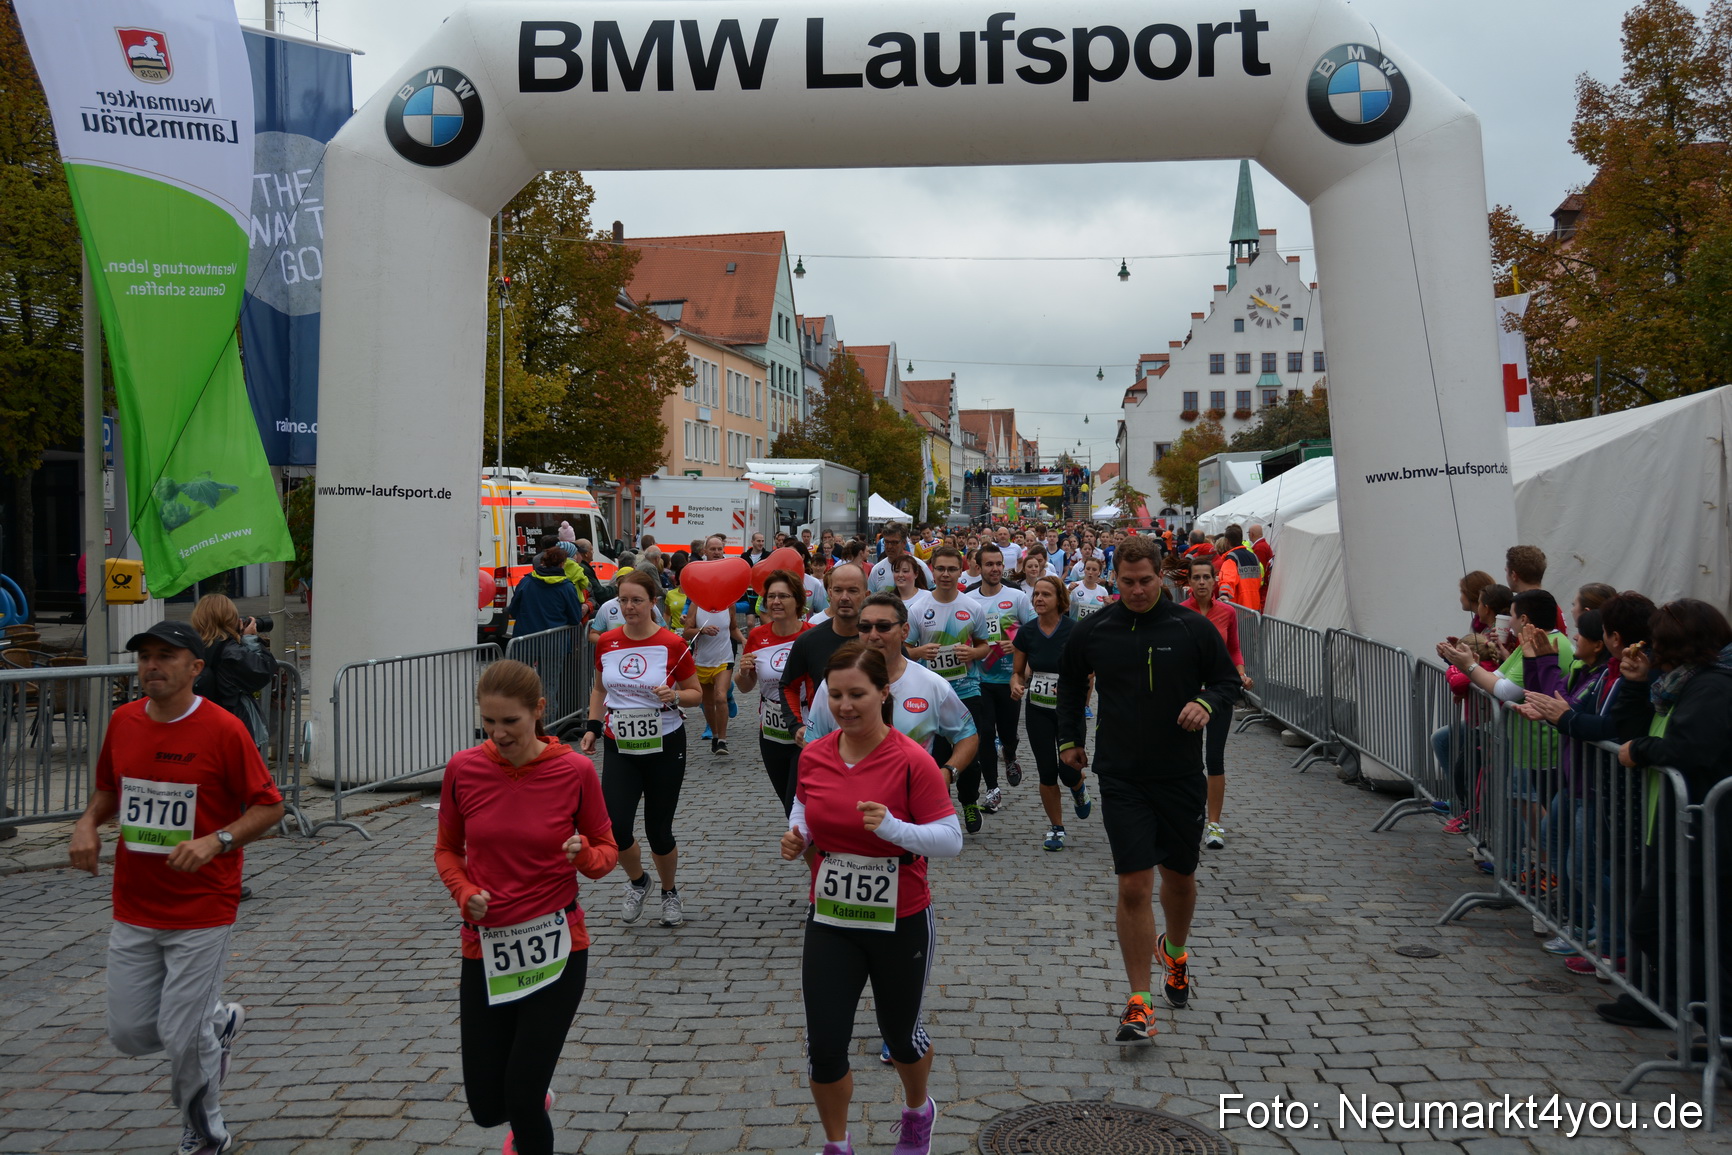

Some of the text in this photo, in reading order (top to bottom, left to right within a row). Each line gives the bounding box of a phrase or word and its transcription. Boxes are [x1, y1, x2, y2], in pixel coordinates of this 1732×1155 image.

[519, 8, 1271, 102] BMW Laufsport
[253, 168, 319, 208] THE
[280, 245, 323, 285] GO
[1365, 462, 1508, 484] www.bmw-laufsport.de
[317, 483, 453, 500] www.bmw-laufsport.de
[617, 719, 658, 738] 5135
[626, 741, 651, 749] Ricarda
[124, 784, 182, 798] PARTL Neumarkt
[127, 796, 188, 827] 5170
[138, 830, 167, 846] Vitaly
[824, 858, 884, 872] PARTL Neumarkt
[823, 869, 890, 903] 5152
[832, 904, 876, 920] Katarina
[482, 920, 552, 940] PARTL Neumarkt
[493, 929, 562, 971] 5137
[517, 966, 545, 988] Karin
